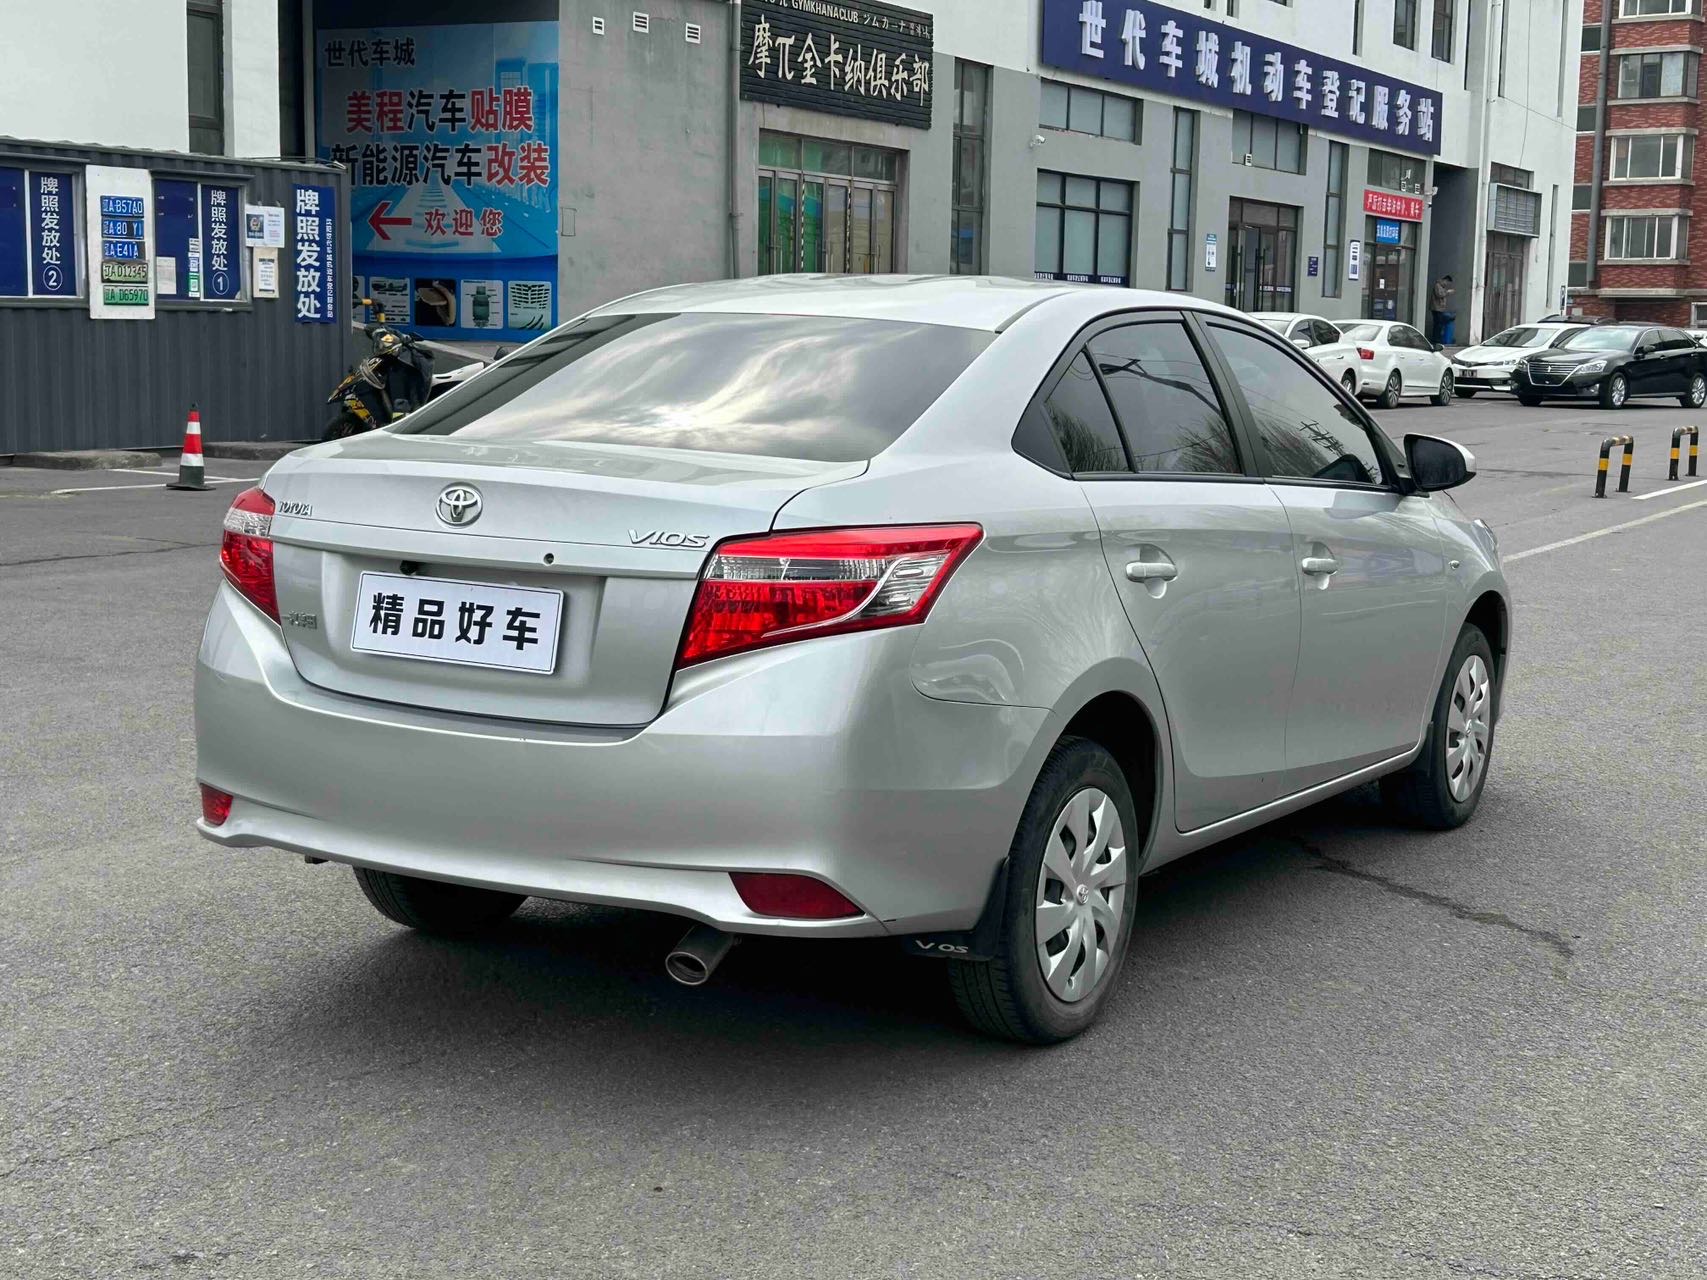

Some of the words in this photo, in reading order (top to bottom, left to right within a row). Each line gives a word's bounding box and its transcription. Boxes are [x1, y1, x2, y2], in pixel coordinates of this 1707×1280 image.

[792, 0, 859, 23] GYMKHANACLUB
[325, 37, 416, 67] 世代车城
[1078, 0, 1434, 142] 世代车城机动车登记服务站
[346, 87, 534, 133] 美程汽车贴膜
[330, 141, 550, 187] 新能源汽车改装
[40, 177, 61, 264] 牌照发放处
[210, 189, 228, 271] 牌照发放处
[424, 208, 503, 238] 欢迎您
[296, 189, 321, 318] 牌照发放处
[627, 528, 713, 549] VIOS
[369, 591, 542, 651] 精品好车
